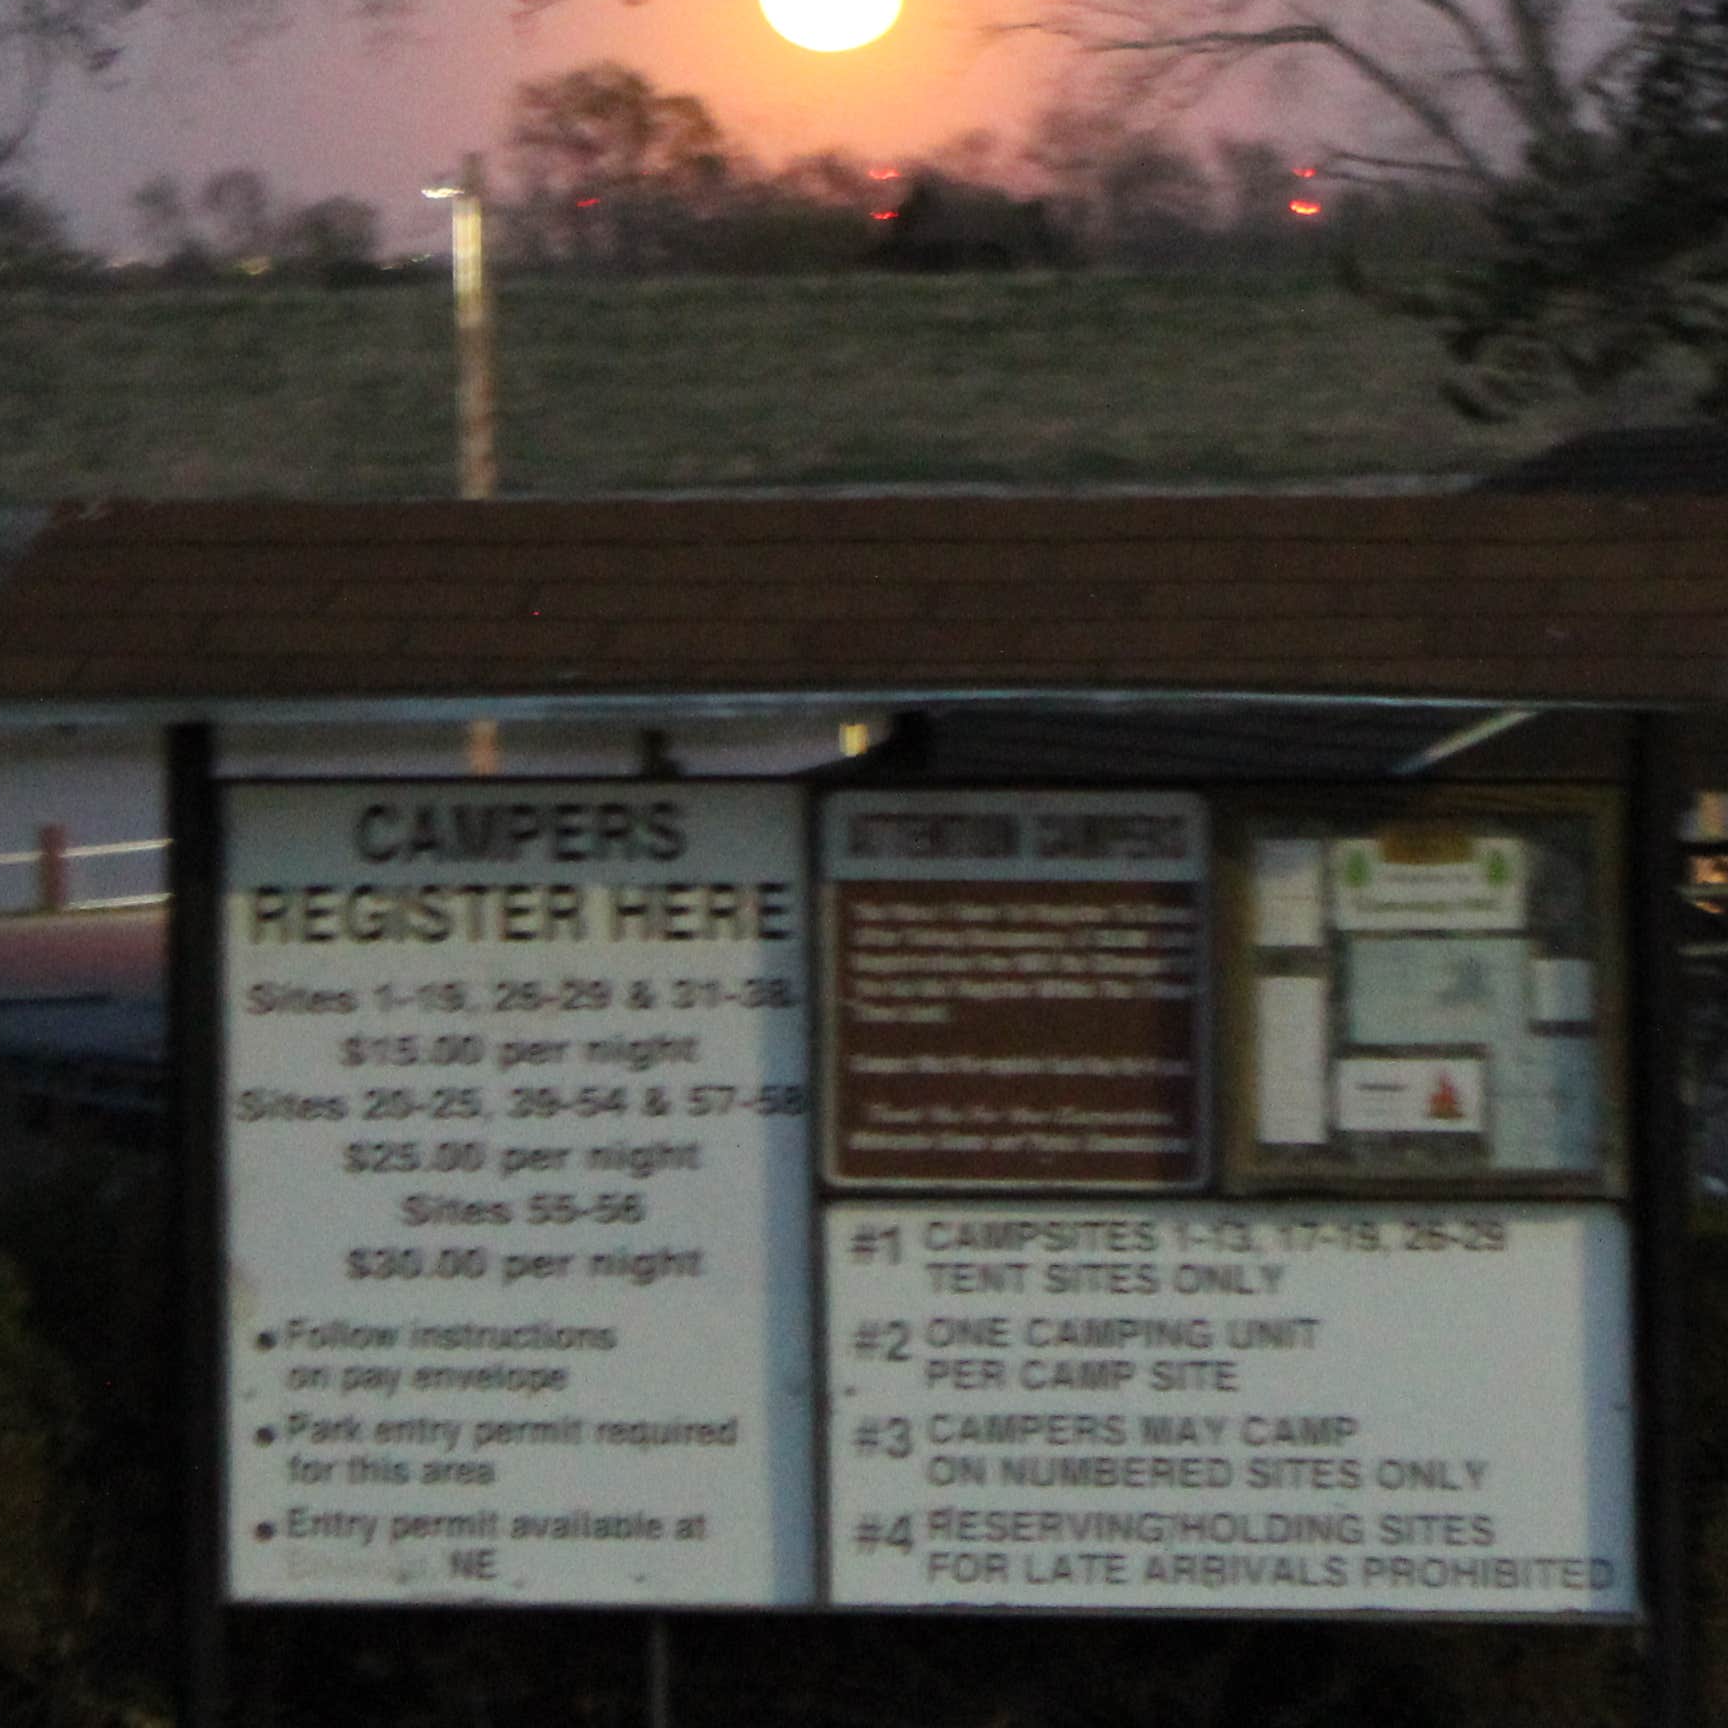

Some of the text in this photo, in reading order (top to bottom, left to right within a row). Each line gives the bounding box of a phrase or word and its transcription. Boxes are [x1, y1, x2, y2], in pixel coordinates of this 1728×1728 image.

[355, 801, 688, 863] CAMPERS
[249, 883, 793, 943] REGISTER HERE
[246, 980, 358, 1014] Sites
[626, 979, 656, 1011] &
[497, 1041, 570, 1075] per
[586, 1036, 699, 1072] night
[236, 1087, 348, 1122] Sites
[641, 1086, 670, 1118] &
[342, 1141, 700, 1181] $25.00 per night
[400, 1193, 510, 1225] Sites
[848, 1224, 902, 1263] #1
[924, 1221, 1156, 1253] CAMPSITES
[501, 1253, 571, 1287] per
[590, 1247, 703, 1284] night
[927, 1262, 1286, 1294] TENT SITES ONLY
[286, 1319, 615, 1351] Follow instructions
[853, 1318, 1321, 1362] #2 ONE CAMPING UNIT
[286, 1362, 569, 1395] on pay envelope
[926, 1360, 1239, 1392] PER CAMP SITE
[286, 1414, 737, 1452] Park entry permit required
[853, 1414, 1358, 1458] #3 CAMPERS MAY CAMP
[288, 1456, 496, 1485] for this area
[927, 1457, 1488, 1489] ON NUMBERED SITES ONLY
[287, 1508, 705, 1547] Entry permit available at
[855, 1514, 915, 1554] #4
[1380, 1512, 1495, 1546] SITES
[448, 1548, 498, 1579] NE
[927, 1553, 1614, 1590] FOR LATE ARRIVALS PROHIBITED
